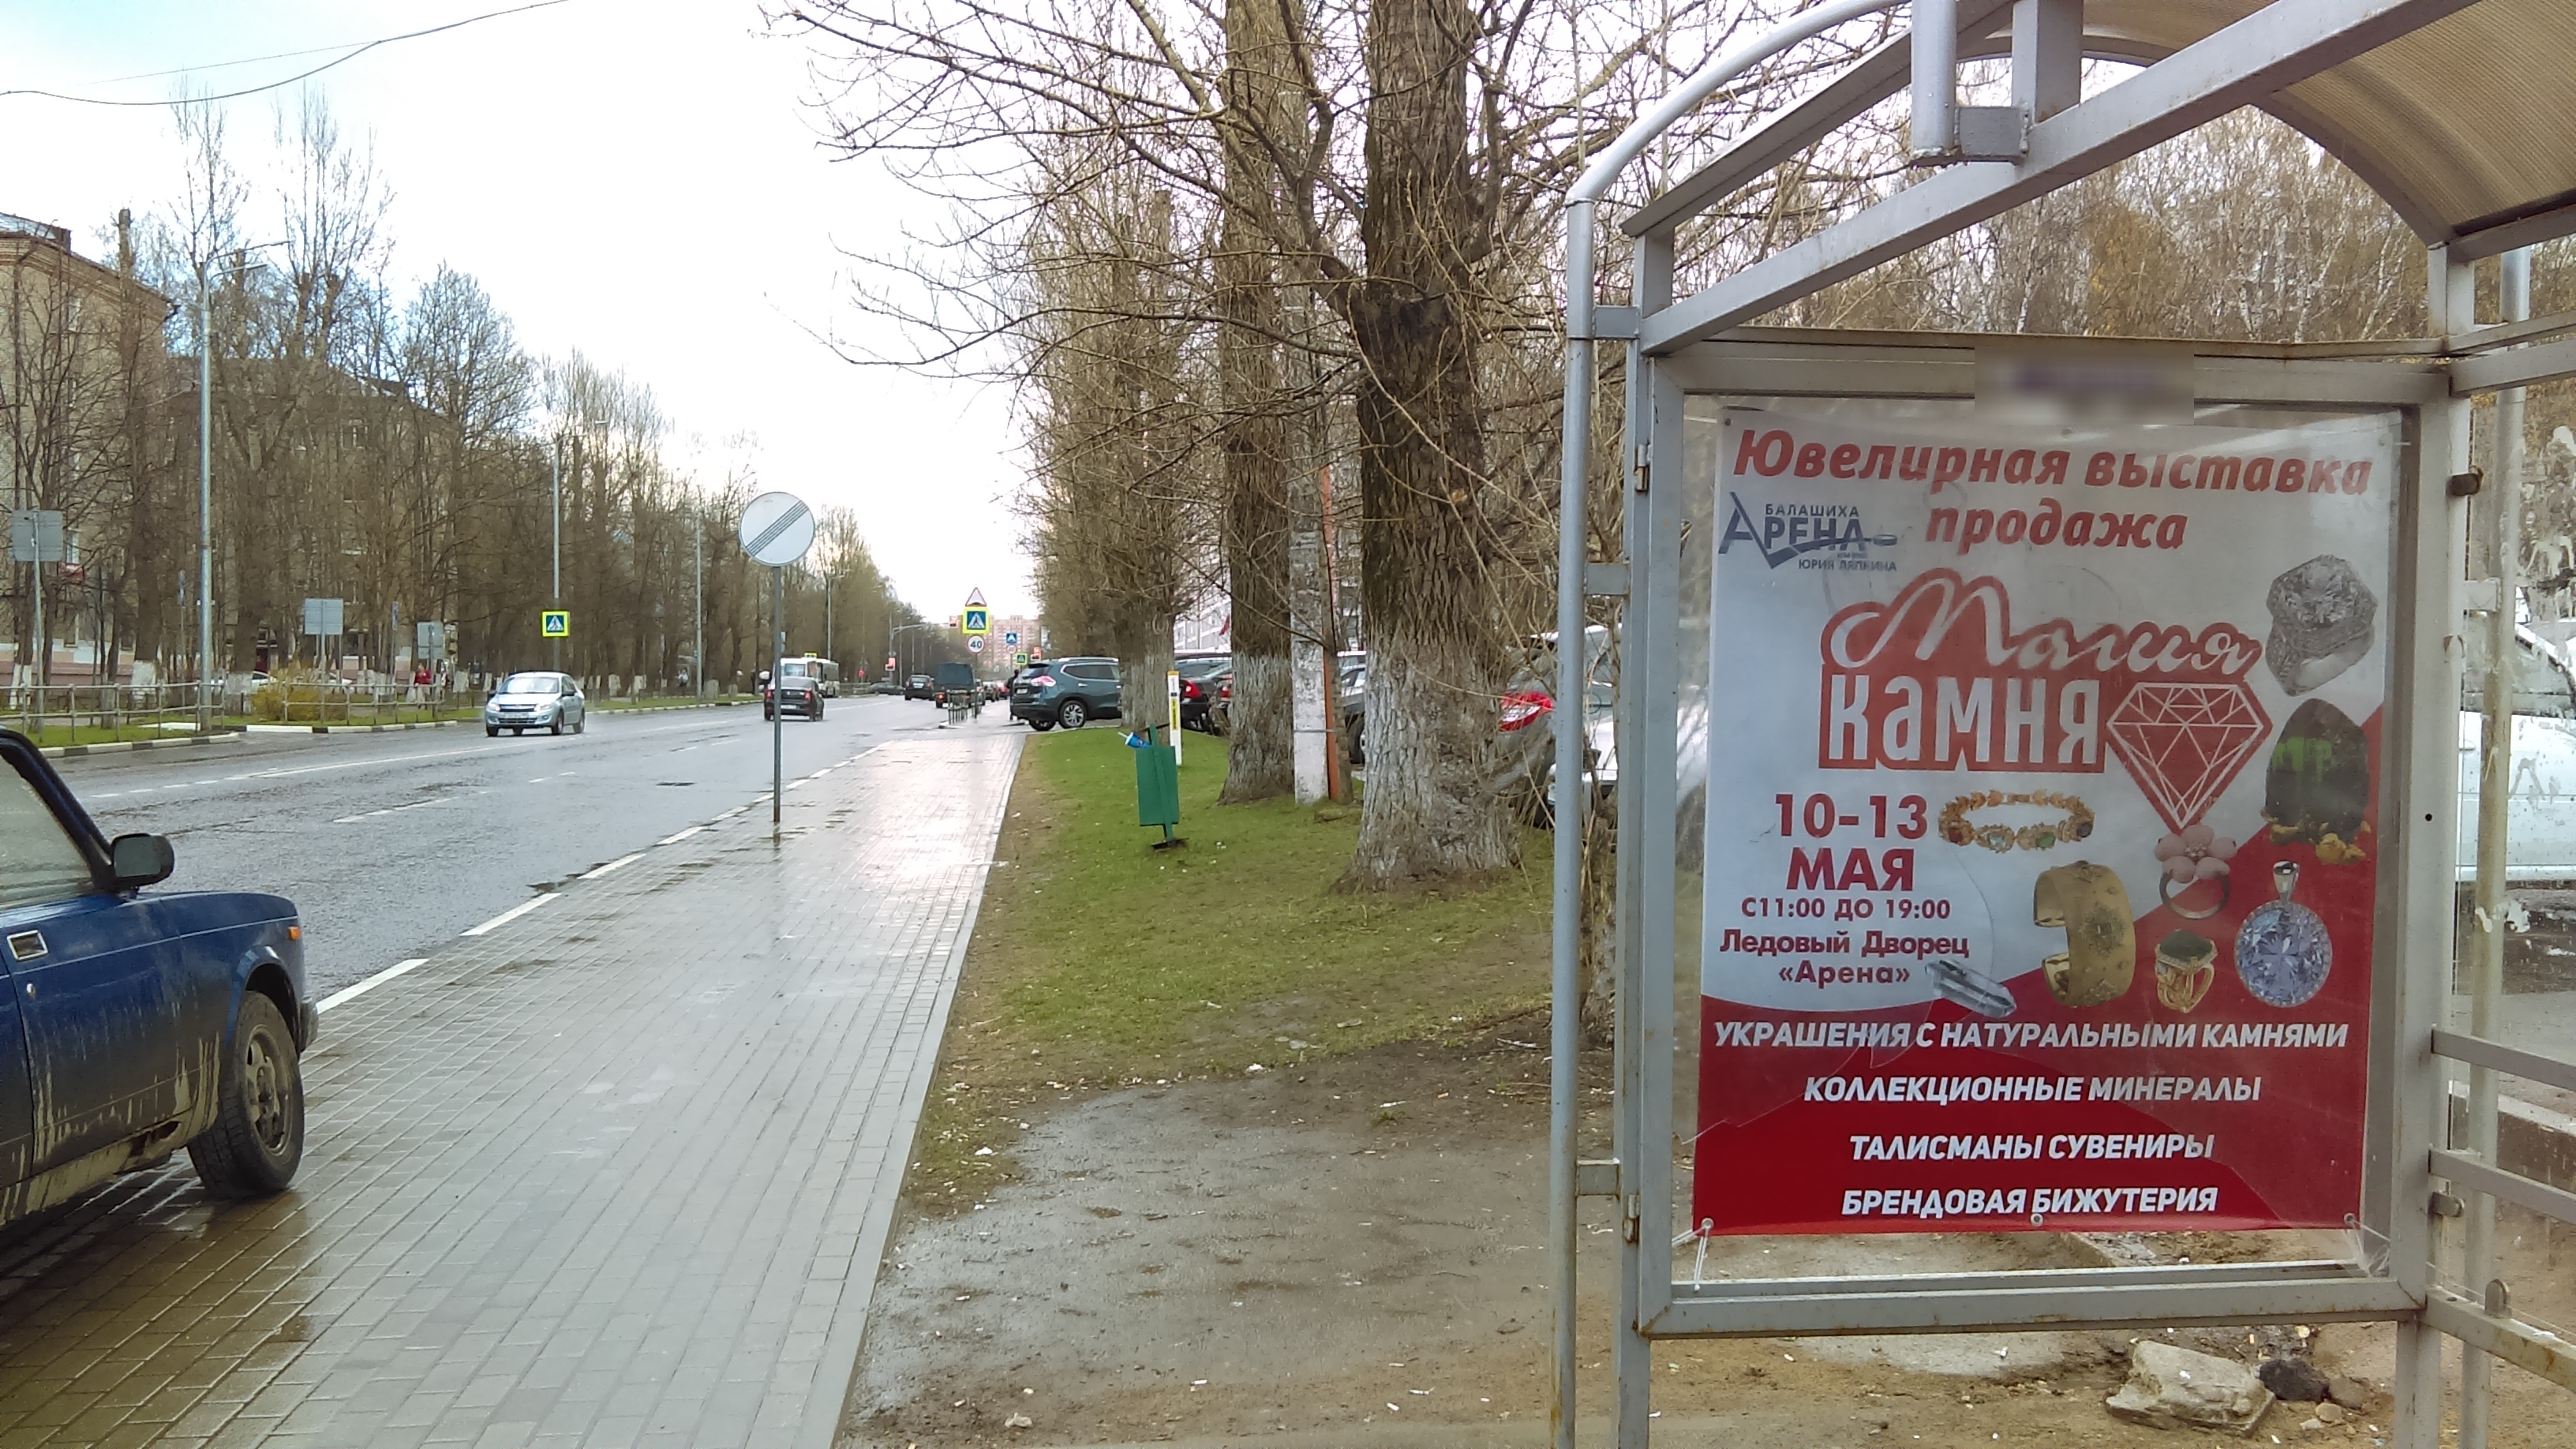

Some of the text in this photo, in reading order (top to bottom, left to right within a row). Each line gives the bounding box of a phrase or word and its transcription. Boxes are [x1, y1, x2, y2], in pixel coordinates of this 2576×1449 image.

[1733, 429, 2372, 496] Ювелирная выставка
[1765, 504, 1859, 518] БАЛАШИХА
[1925, 497, 2188, 556] продажа
[1798, 559, 1834, 571] ЮРИЯ
[1830, 577, 2260, 676] Магия
[970, 640, 983, 650] 40
[1775, 792, 1928, 840] 10-13
[1786, 847, 1915, 892] МАЯ
[1834, 898, 1874, 922] ДО
[1886, 899, 1951, 919] 19:00
[1719, 928, 1970, 960] Ледовый Дворец
[1778, 960, 1911, 990] «Арена»
[1714, 1022, 2349, 1048] УКРАШЕНИЯ С НАТУРАЛЬНЫМИ КАМНЯМИ
[1803, 1076, 2262, 1106] КОЛЛЕКЦИОННЫЕ МИНЕРАЛЫ
[1850, 1134, 2215, 1160] ТАЛИСМАНЫ СУВЕНИРЫ
[1841, 1187, 2218, 1219] БРЕНДОВАЯ БИЖУТЕРИЯ
